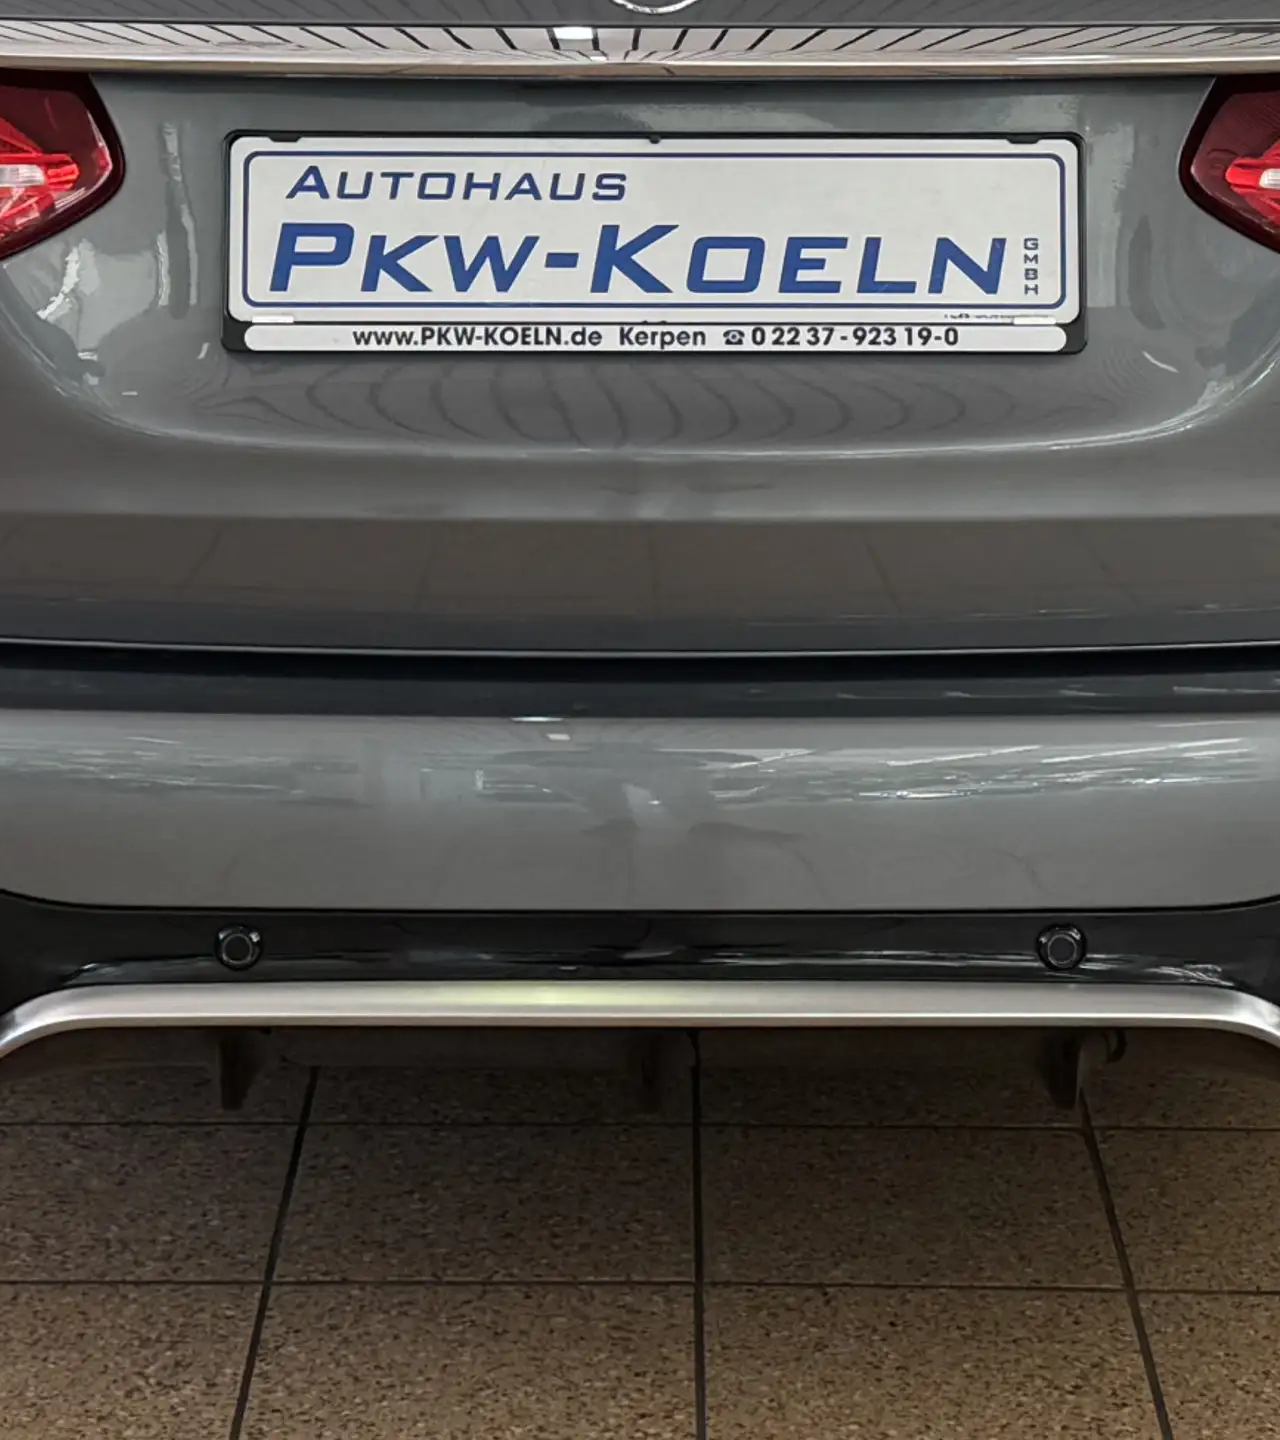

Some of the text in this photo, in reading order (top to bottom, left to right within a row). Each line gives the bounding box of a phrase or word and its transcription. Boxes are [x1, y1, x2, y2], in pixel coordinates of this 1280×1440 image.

[286, 166, 627, 201] AUTOHAUS
[269, 222, 1007, 295] PKW-KOELN
[1023, 237, 1039, 295] GMBH
[352, 326, 603, 347] www.PKW-KOELN.de
[619, 326, 706, 350] Kerpen
